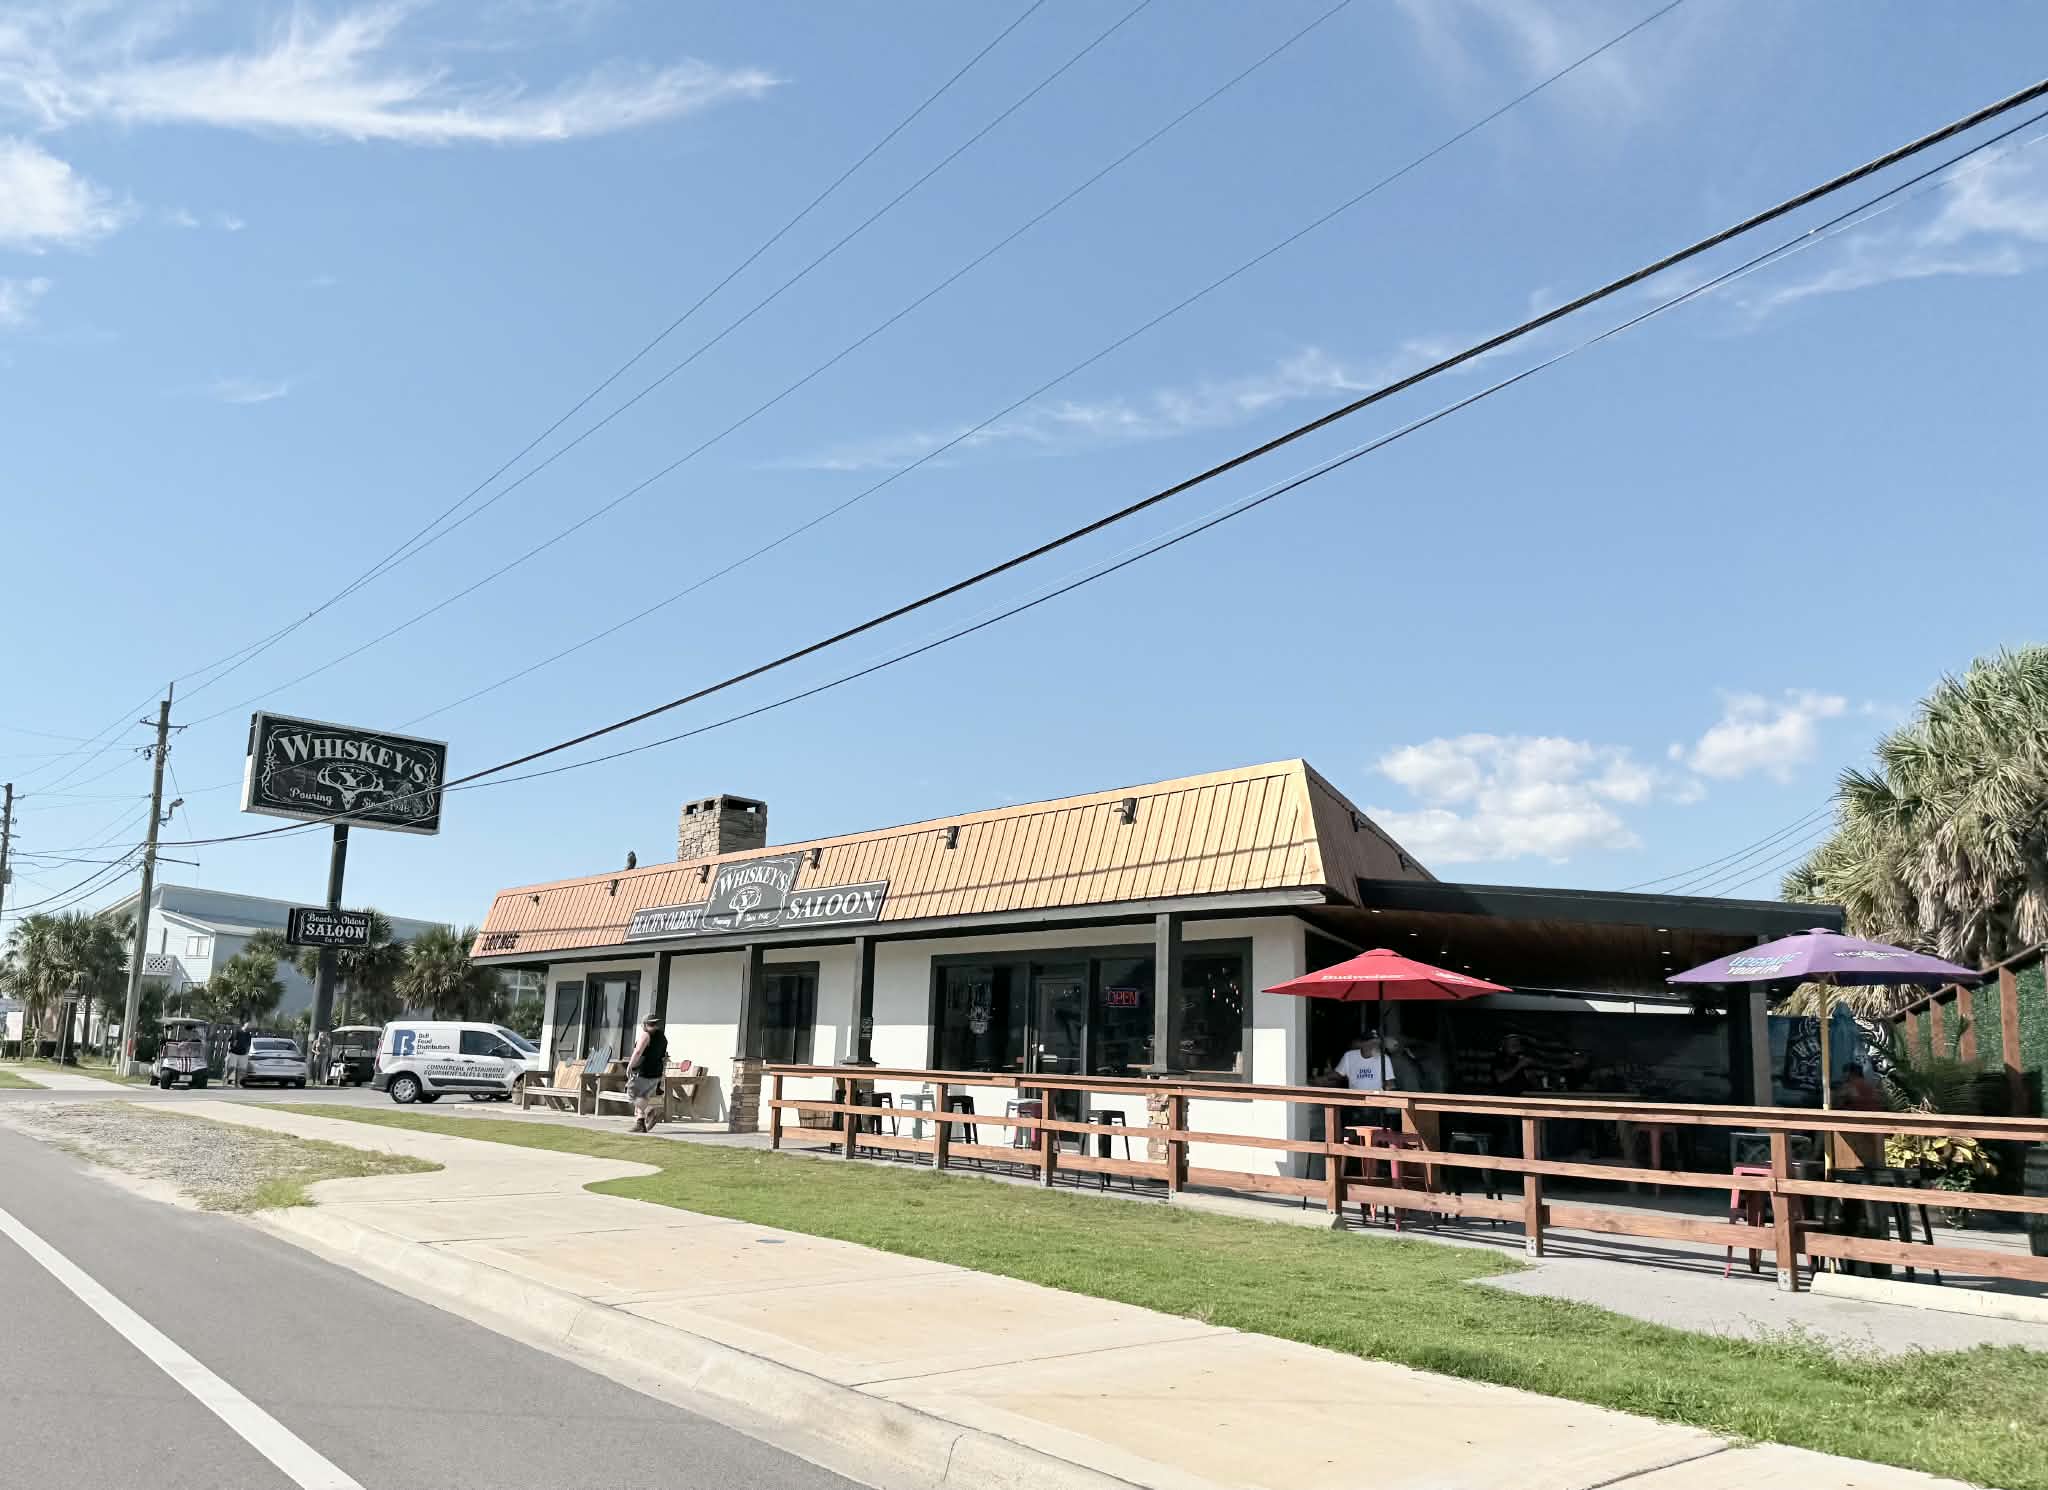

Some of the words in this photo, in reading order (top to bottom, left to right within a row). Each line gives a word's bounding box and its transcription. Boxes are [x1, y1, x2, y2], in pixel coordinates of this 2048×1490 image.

[278, 733, 428, 783] WHISKEY'S
[290, 786, 333, 806] Pouring
[720, 866, 789, 896] WHISKEY'S
[786, 888, 879, 920] SALOON
[307, 912, 338, 924] Beach's
[341, 915, 366, 925] Oldest
[664, 909, 703, 930] OLDEST
[305, 922, 367, 938] SALOON
[1106, 991, 1137, 1002] OPEN
